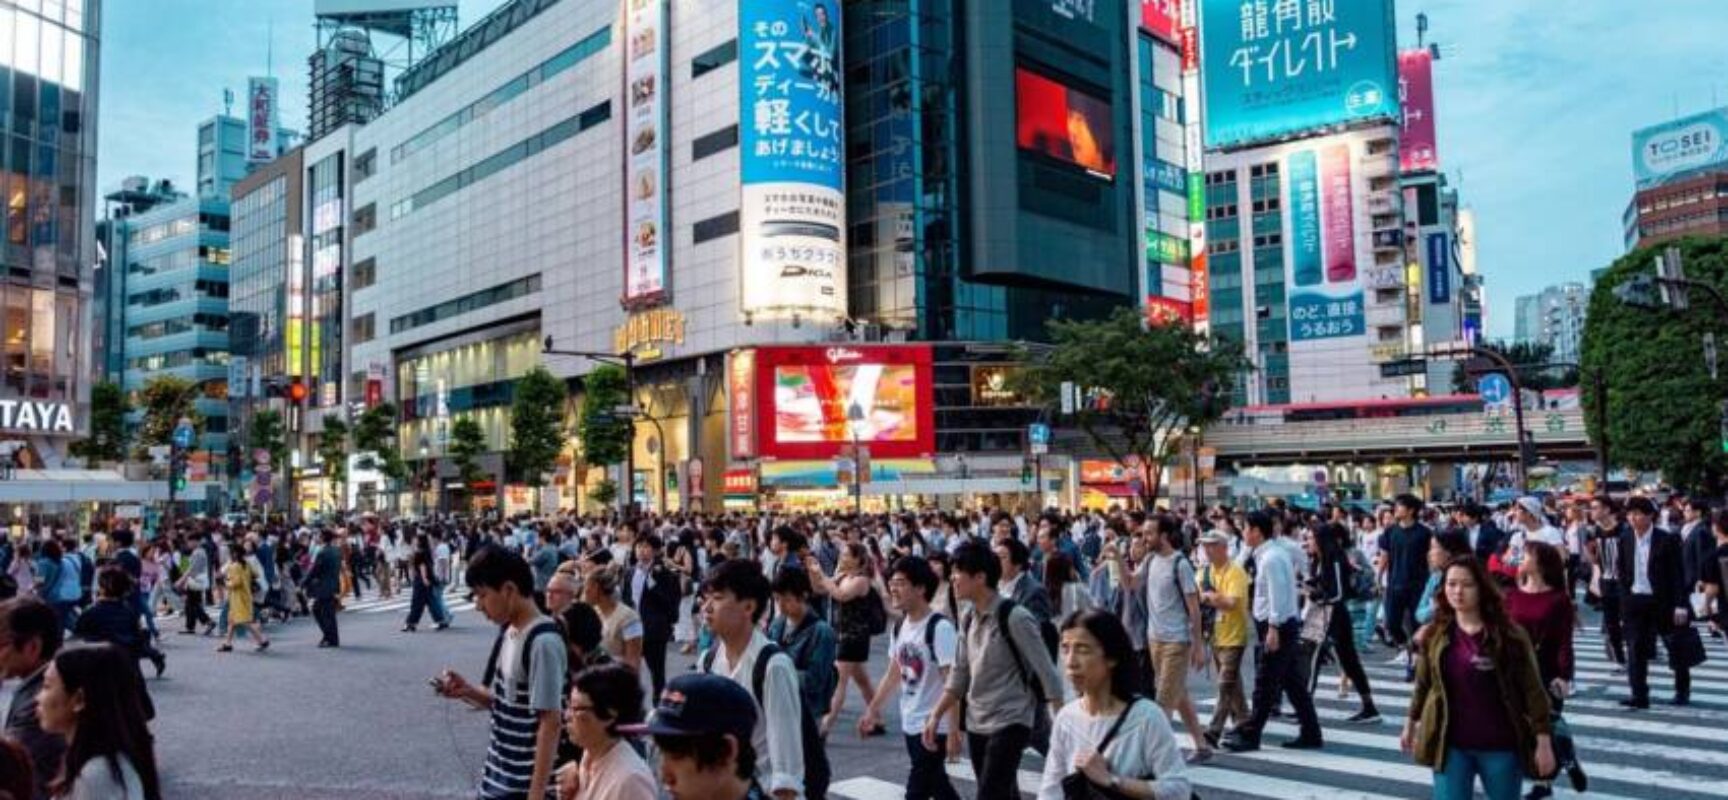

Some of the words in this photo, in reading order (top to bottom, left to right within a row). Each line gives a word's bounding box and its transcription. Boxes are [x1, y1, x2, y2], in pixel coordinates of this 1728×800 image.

[753, 20, 788, 37] その
[754, 98, 840, 143] 軽くして
[1648, 129, 1711, 156] TOSEI
